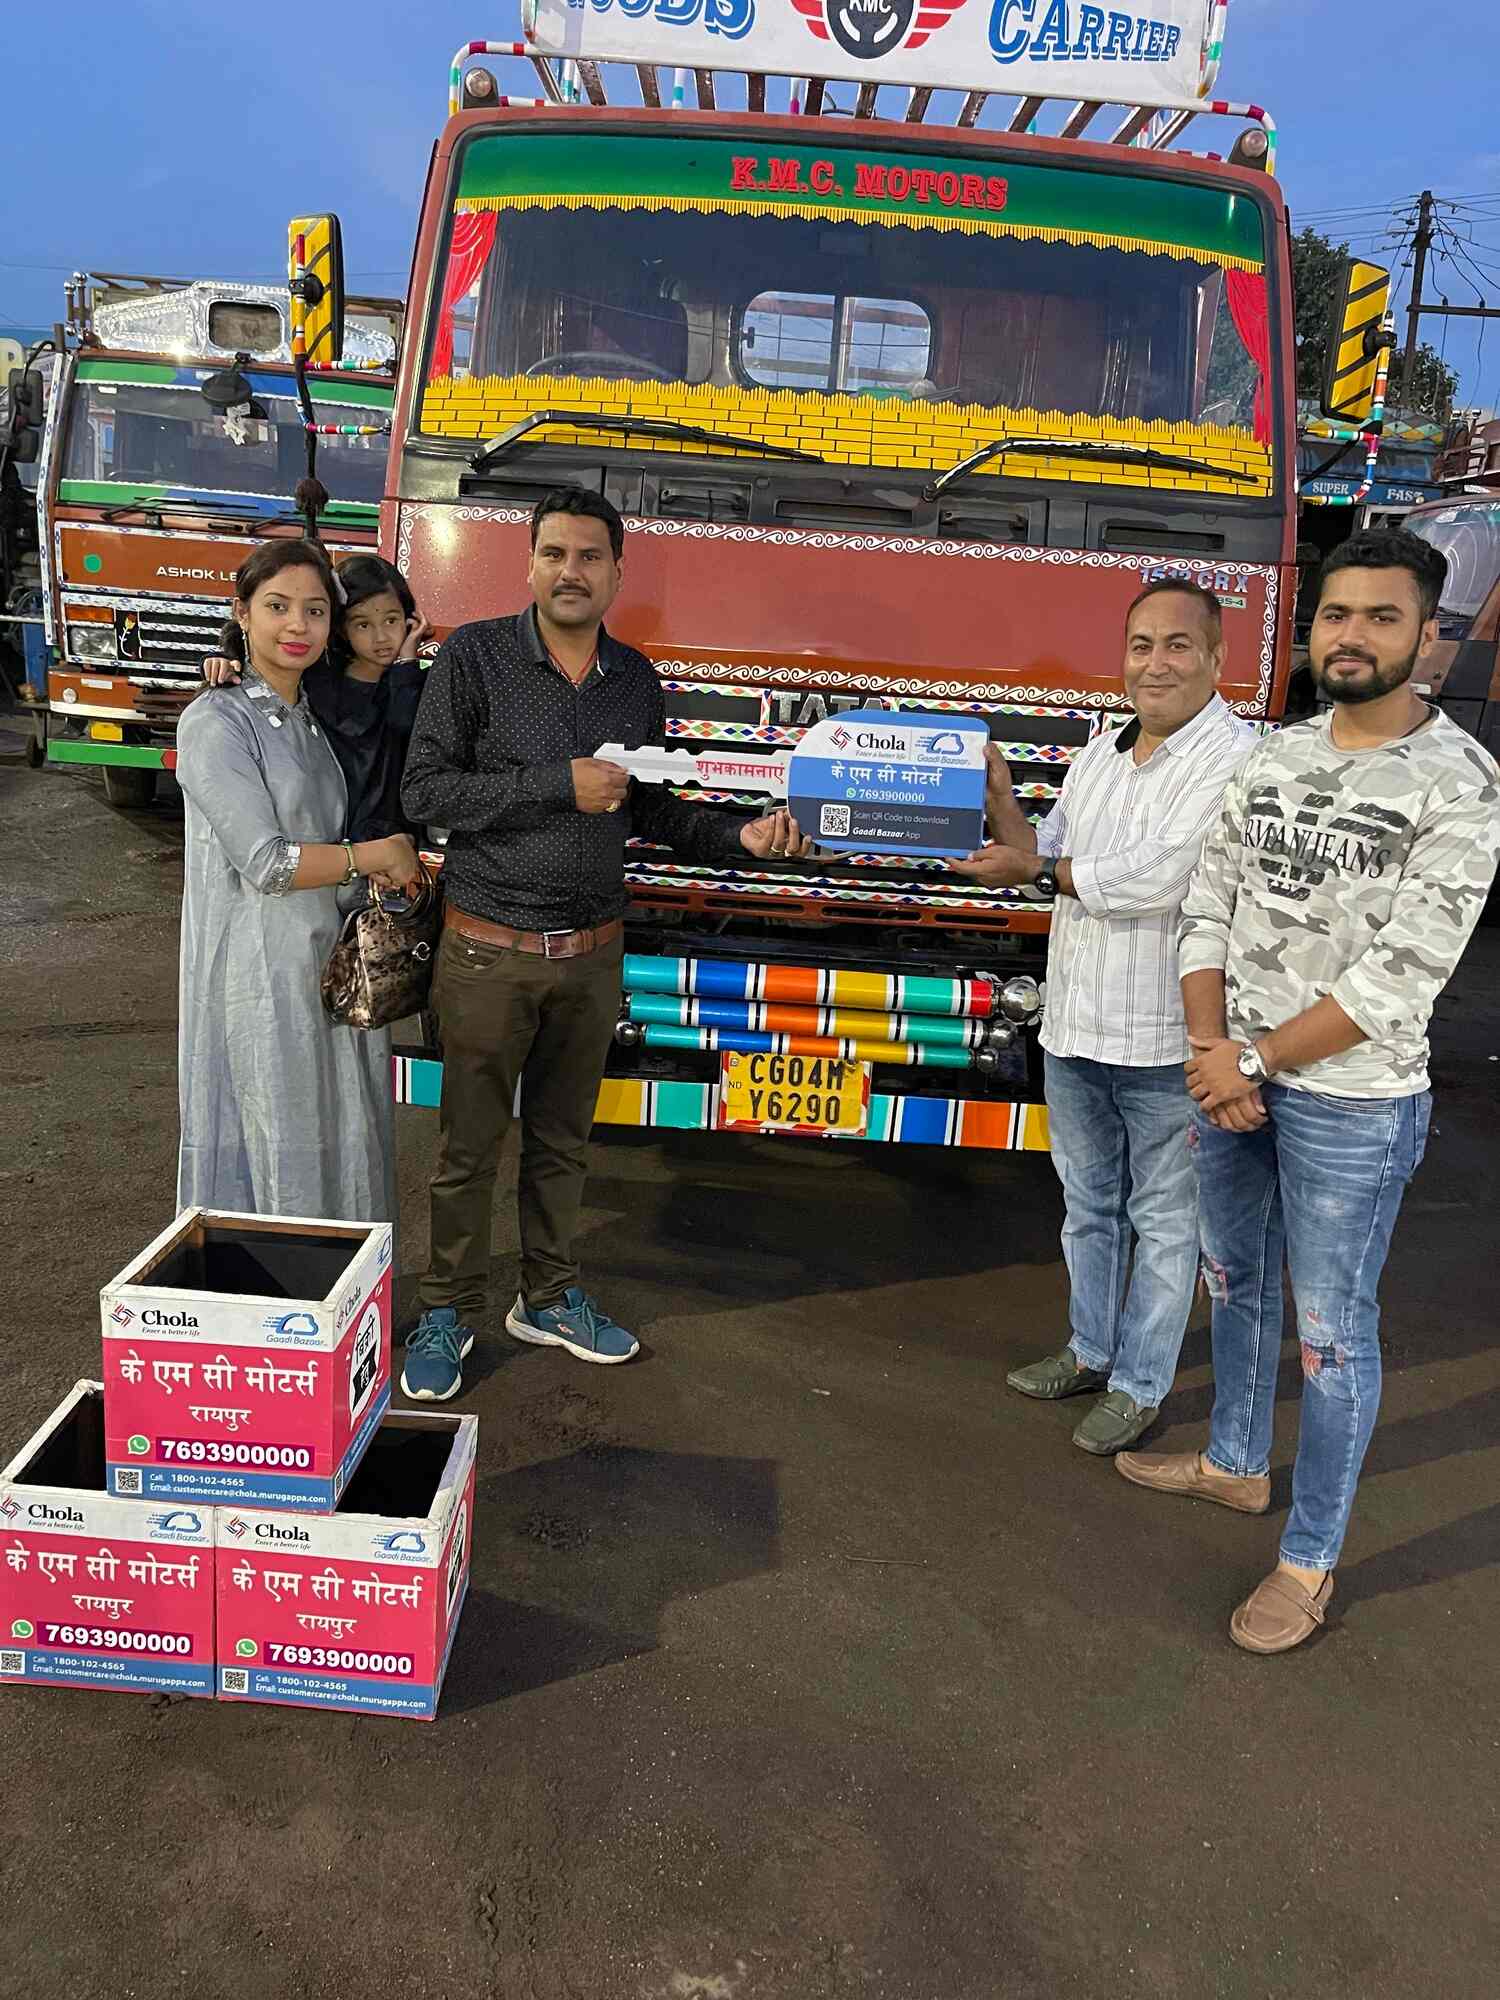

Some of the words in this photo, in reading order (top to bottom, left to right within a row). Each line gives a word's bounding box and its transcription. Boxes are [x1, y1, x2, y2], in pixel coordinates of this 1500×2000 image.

[988, 0, 1181, 64] CARRIER
[730, 156, 843, 196] K.M.C.
[855, 163, 1009, 211] MOTORS
[1312, 481, 1349, 495] SUPER
[156, 566, 216, 581] ASHOK
[857, 732, 905, 751] Chola
[831, 761, 845, 780] के
[850, 767, 872, 785] एम
[877, 764, 896, 785] सी
[901, 767, 943, 787] मोटर्स
[859, 789, 925, 803] 7693900000
[884, 812, 903, 822] Code
[913, 815, 950, 825] download
[853, 827, 876, 836] Gaadi
[877, 829, 904, 838] Bazaar
[750, 1054, 843, 1090] CG04M
[749, 1089, 840, 1125] Y6290
[141, 1310, 199, 1328] Chola
[120, 1350, 145, 1385] के
[152, 1360, 193, 1394] एम
[202, 1354, 237, 1391] सी
[244, 1357, 318, 1397] मोटर्स
[189, 1405, 252, 1430] रायपुर
[161, 1439, 310, 1468] 7693900000
[171, 1474, 245, 1487] 1800-102-4565
[28, 1504, 84, 1522] Chola
[255, 1523, 310, 1541] Chola
[6, 1540, 30, 1573] के
[37, 1551, 77, 1583] एम
[86, 1548, 120, 1581] सी
[128, 1552, 200, 1589] मोटर्स
[232, 1559, 256, 1592] के
[263, 1571, 303, 1602] एम
[311, 1567, 344, 1601] सी
[351, 1572, 424, 1609] मोटर्स
[72, 1594, 134, 1619] रायपुर
[45, 1624, 191, 1654] 7693900000
[296, 1613, 357, 1640] रायपुर
[54, 1657, 125, 1671] 1800-102-4565
[269, 1644, 412, 1674] 7693900000
[277, 1676, 347, 1691] 1800-102-4565
